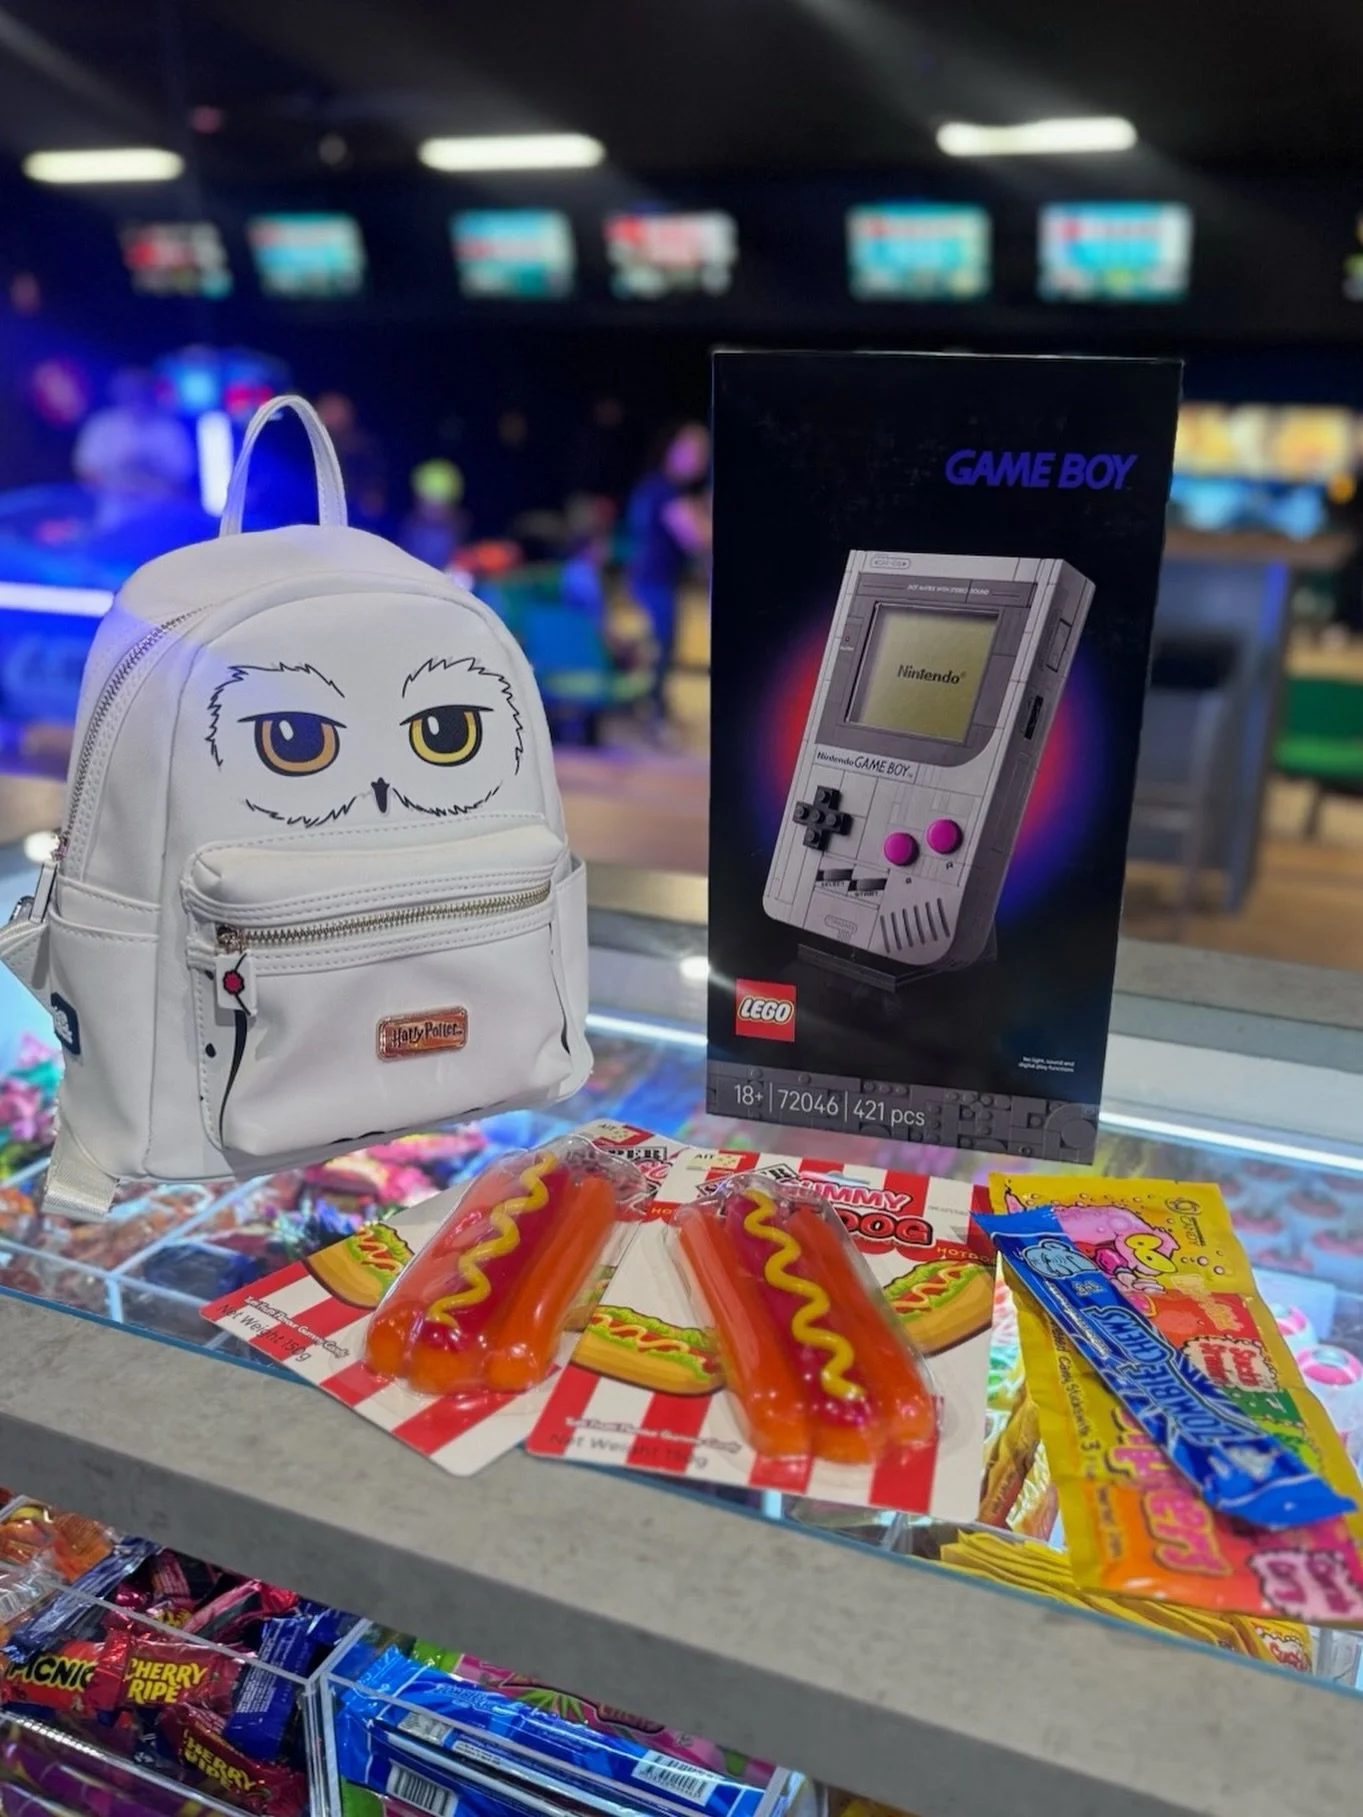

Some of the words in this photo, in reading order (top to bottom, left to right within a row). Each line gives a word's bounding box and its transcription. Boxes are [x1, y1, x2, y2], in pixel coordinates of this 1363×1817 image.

[945, 449, 1056, 487] GAME
[1059, 453, 1138, 490] BOY
[897, 664, 961, 685] Nintendo
[817, 752, 854, 766] Nintendo
[855, 756, 886, 773] GAME
[887, 762, 910, 777] BOY
[739, 997, 794, 1025] LEGO
[392, 1026, 424, 1048] Harry
[424, 1021, 458, 1040] Potter
[734, 1085, 764, 1106] 18+
[777, 1090, 839, 1116] 72046
[853, 1100, 885, 1121] 421
[891, 1108, 925, 1127] pcs
[937, 1247, 990, 1263] HOTDO
[218, 1304, 242, 1320] Net
[240, 1314, 285, 1345] Weight
[1080, 1305, 1174, 1366] CHEWS
[1118, 1360, 1270, 1441] ZOMBIE
[128, 1681, 180, 1705] RIPE
